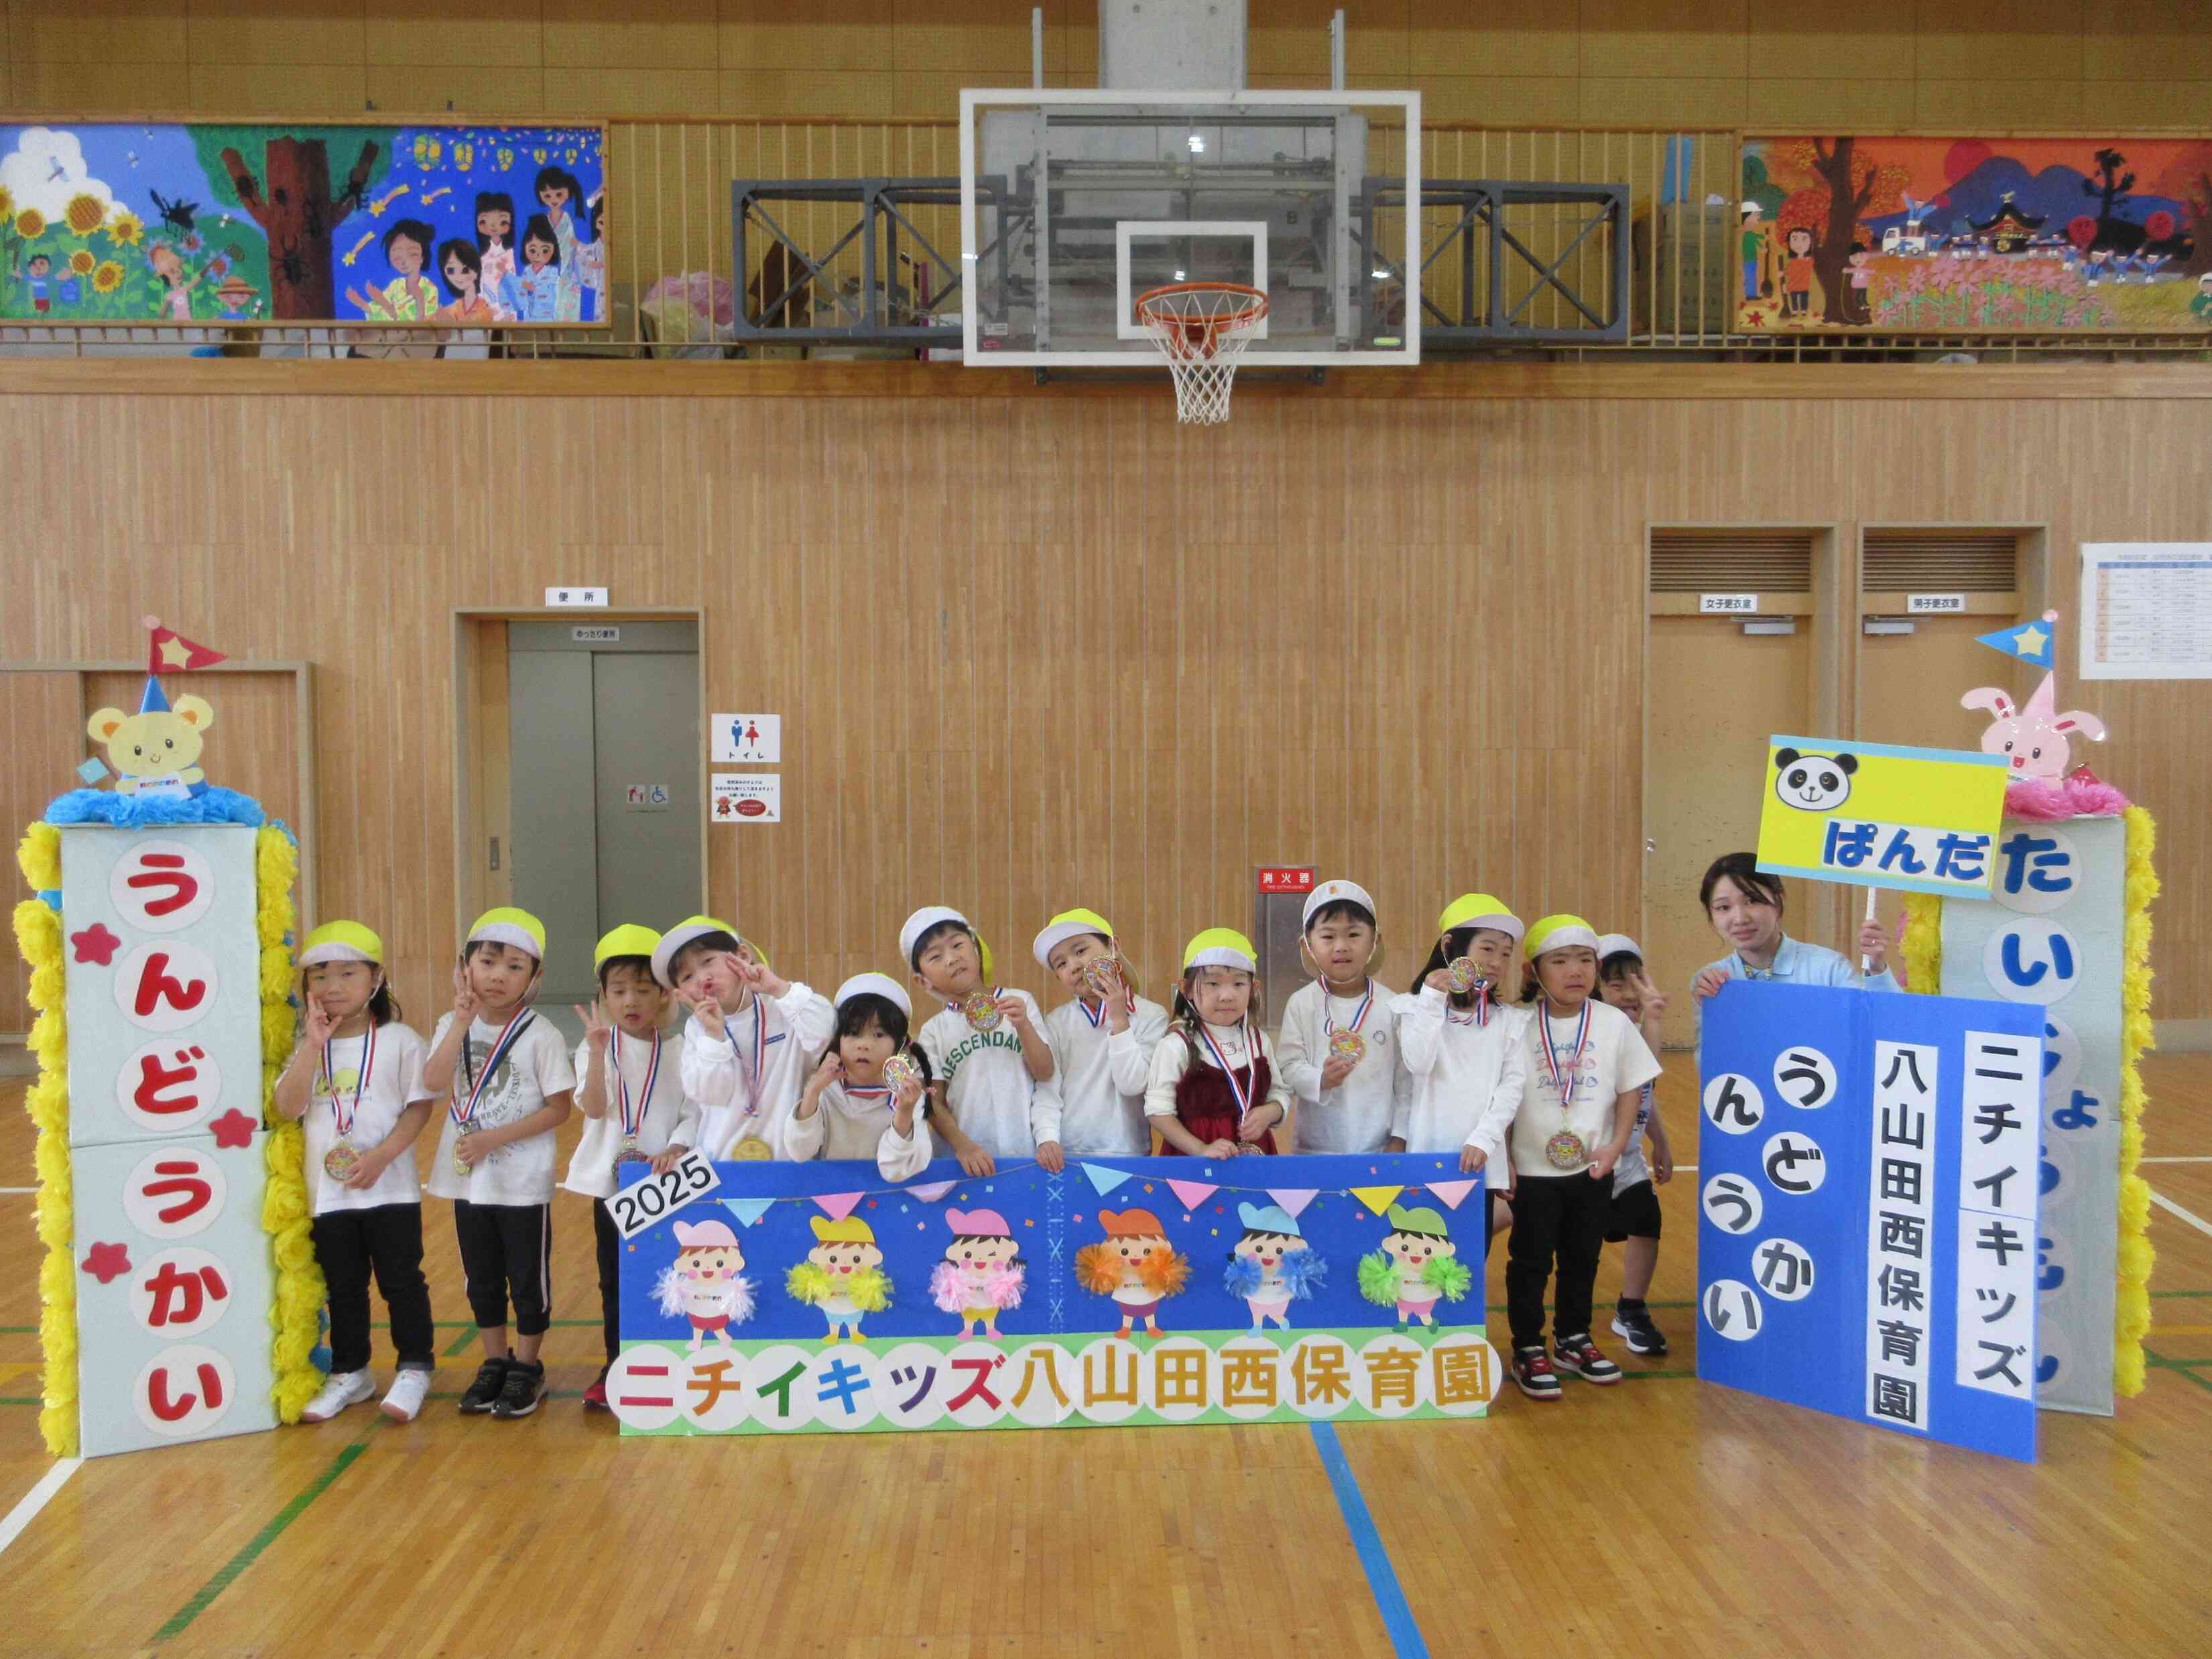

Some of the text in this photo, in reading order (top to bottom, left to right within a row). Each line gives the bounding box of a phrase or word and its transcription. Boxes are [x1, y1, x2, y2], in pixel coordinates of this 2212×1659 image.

[558, 592, 594, 602] 便所
[1706, 599, 1752, 609] 女子更衣室
[1914, 599, 1959, 609] 男子更衣室
[1263, 873, 1309, 883] 消火器
[1823, 821, 1990, 881] ぱんだ
[127, 853, 228, 1421] うんどうかい
[615, 1154, 711, 1233] 2025
[1973, 1045, 2026, 1388] ニチイキッズ
[1873, 1049, 1928, 1424] 八山田西保育園
